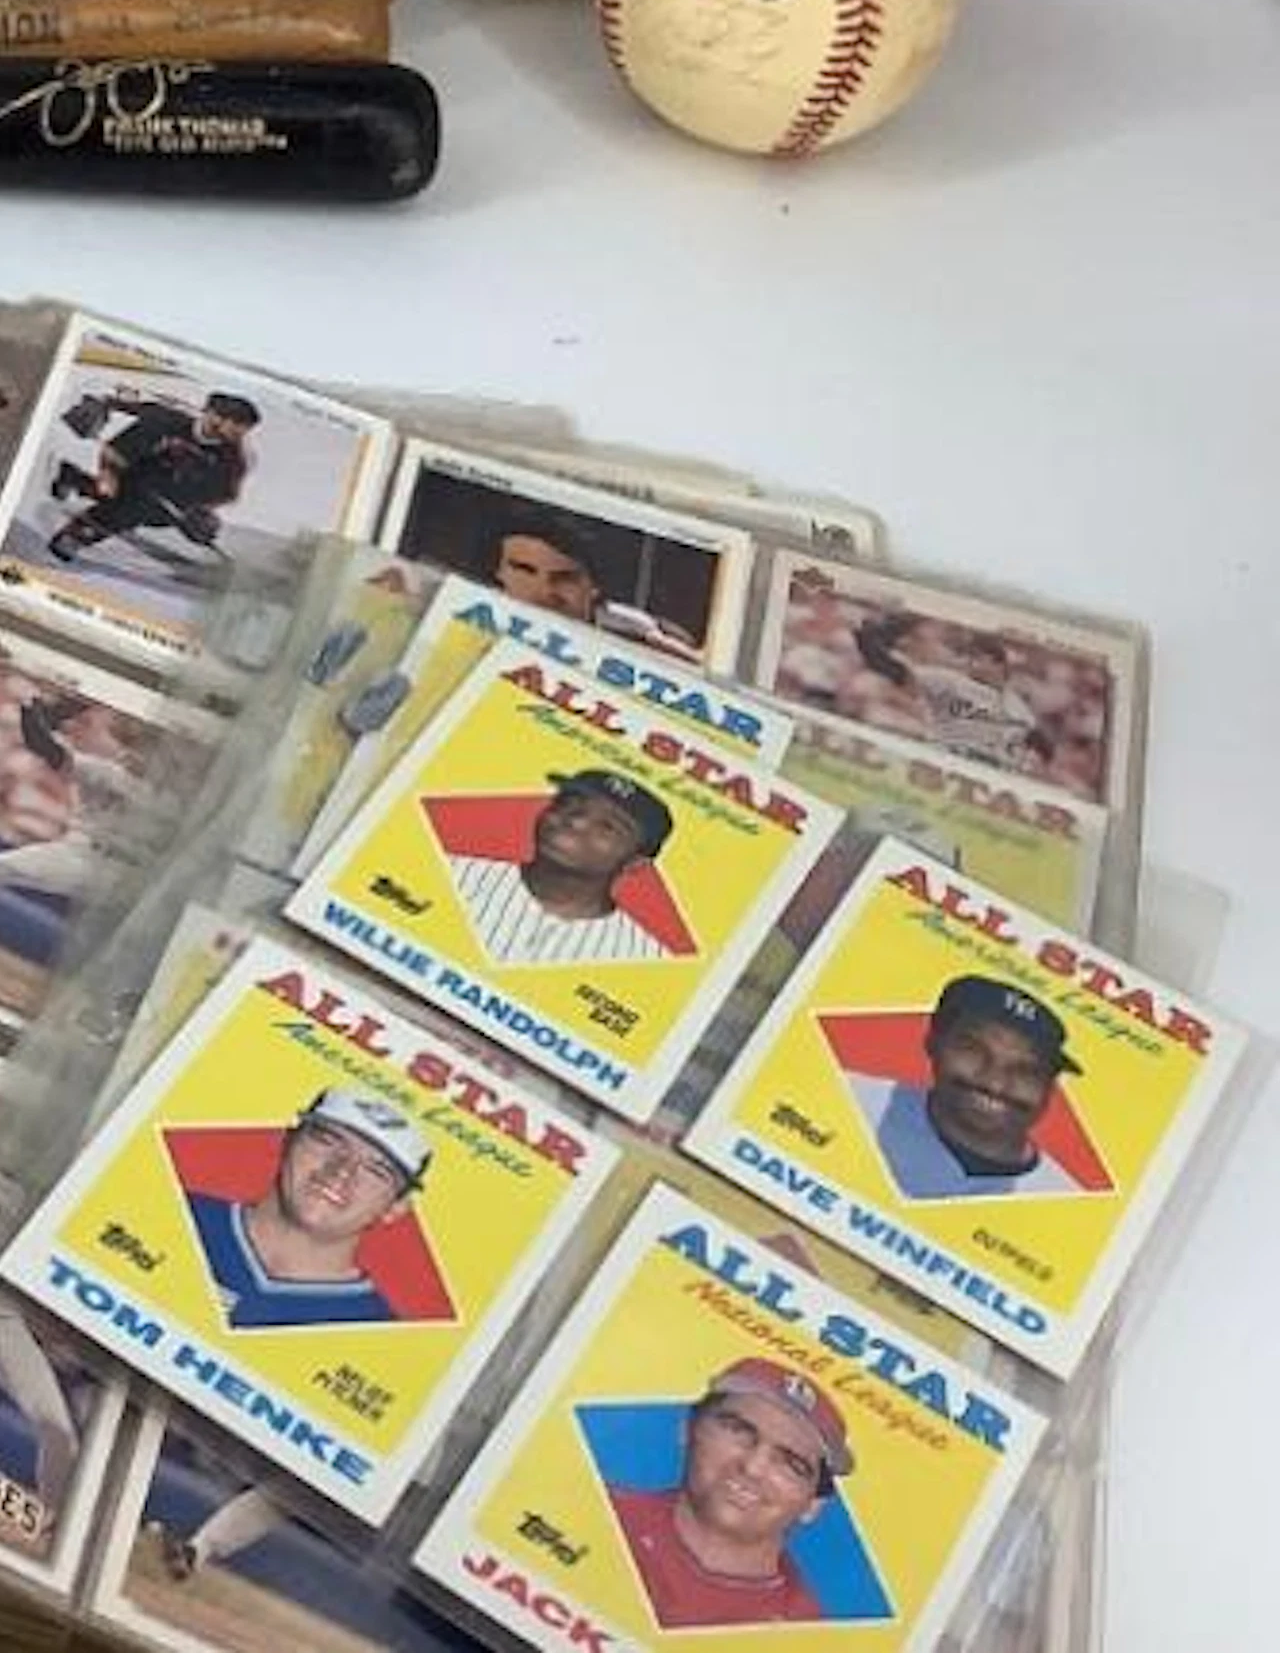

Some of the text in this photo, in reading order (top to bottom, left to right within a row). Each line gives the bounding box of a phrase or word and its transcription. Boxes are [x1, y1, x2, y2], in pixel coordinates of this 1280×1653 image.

[452, 600, 764, 748] ALL STAR
[499, 664, 810, 835] ALL STAR
[322, 900, 628, 1091] WILLIE RANDOLPH
[884, 864, 1214, 1056] ALL STAR
[253, 969, 589, 1176] ALL STAR
[682, 1276, 831, 1375] National
[732, 1137, 1048, 1336] DAVE WINFIELD
[45, 1255, 377, 1487] TOM HENKE
[657, 1222, 1016, 1453] ALL STAR
[461, 1551, 616, 1653] JACK
